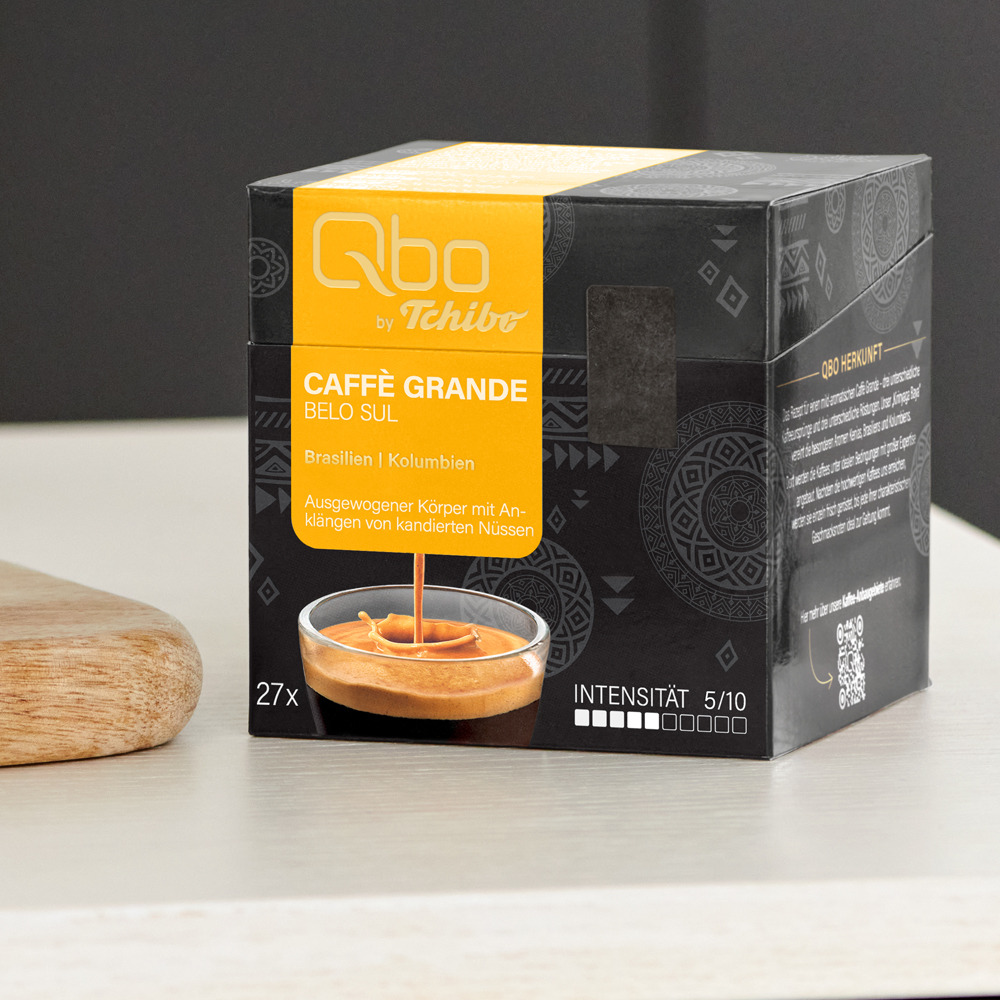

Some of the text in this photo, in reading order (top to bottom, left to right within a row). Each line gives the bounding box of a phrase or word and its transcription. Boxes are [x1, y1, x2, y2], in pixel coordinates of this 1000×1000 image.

[313, 212, 489, 296] Qbo
[376, 300, 528, 333] by Tchibo
[822, 342, 882, 380] QBO HERKUNFT
[304, 369, 527, 402] CAFFÈ GRANDE
[304, 402, 398, 422] BELO SUL
[304, 450, 474, 470] Brasilien Kolumbien
[304, 494, 526, 517] Ausgewogener Körper mit An-
[305, 512, 534, 537] klängen von kandierten Nüssen
[256, 682, 299, 707] 27x
[574, 684, 746, 711] INTENSITÄT 5/10
